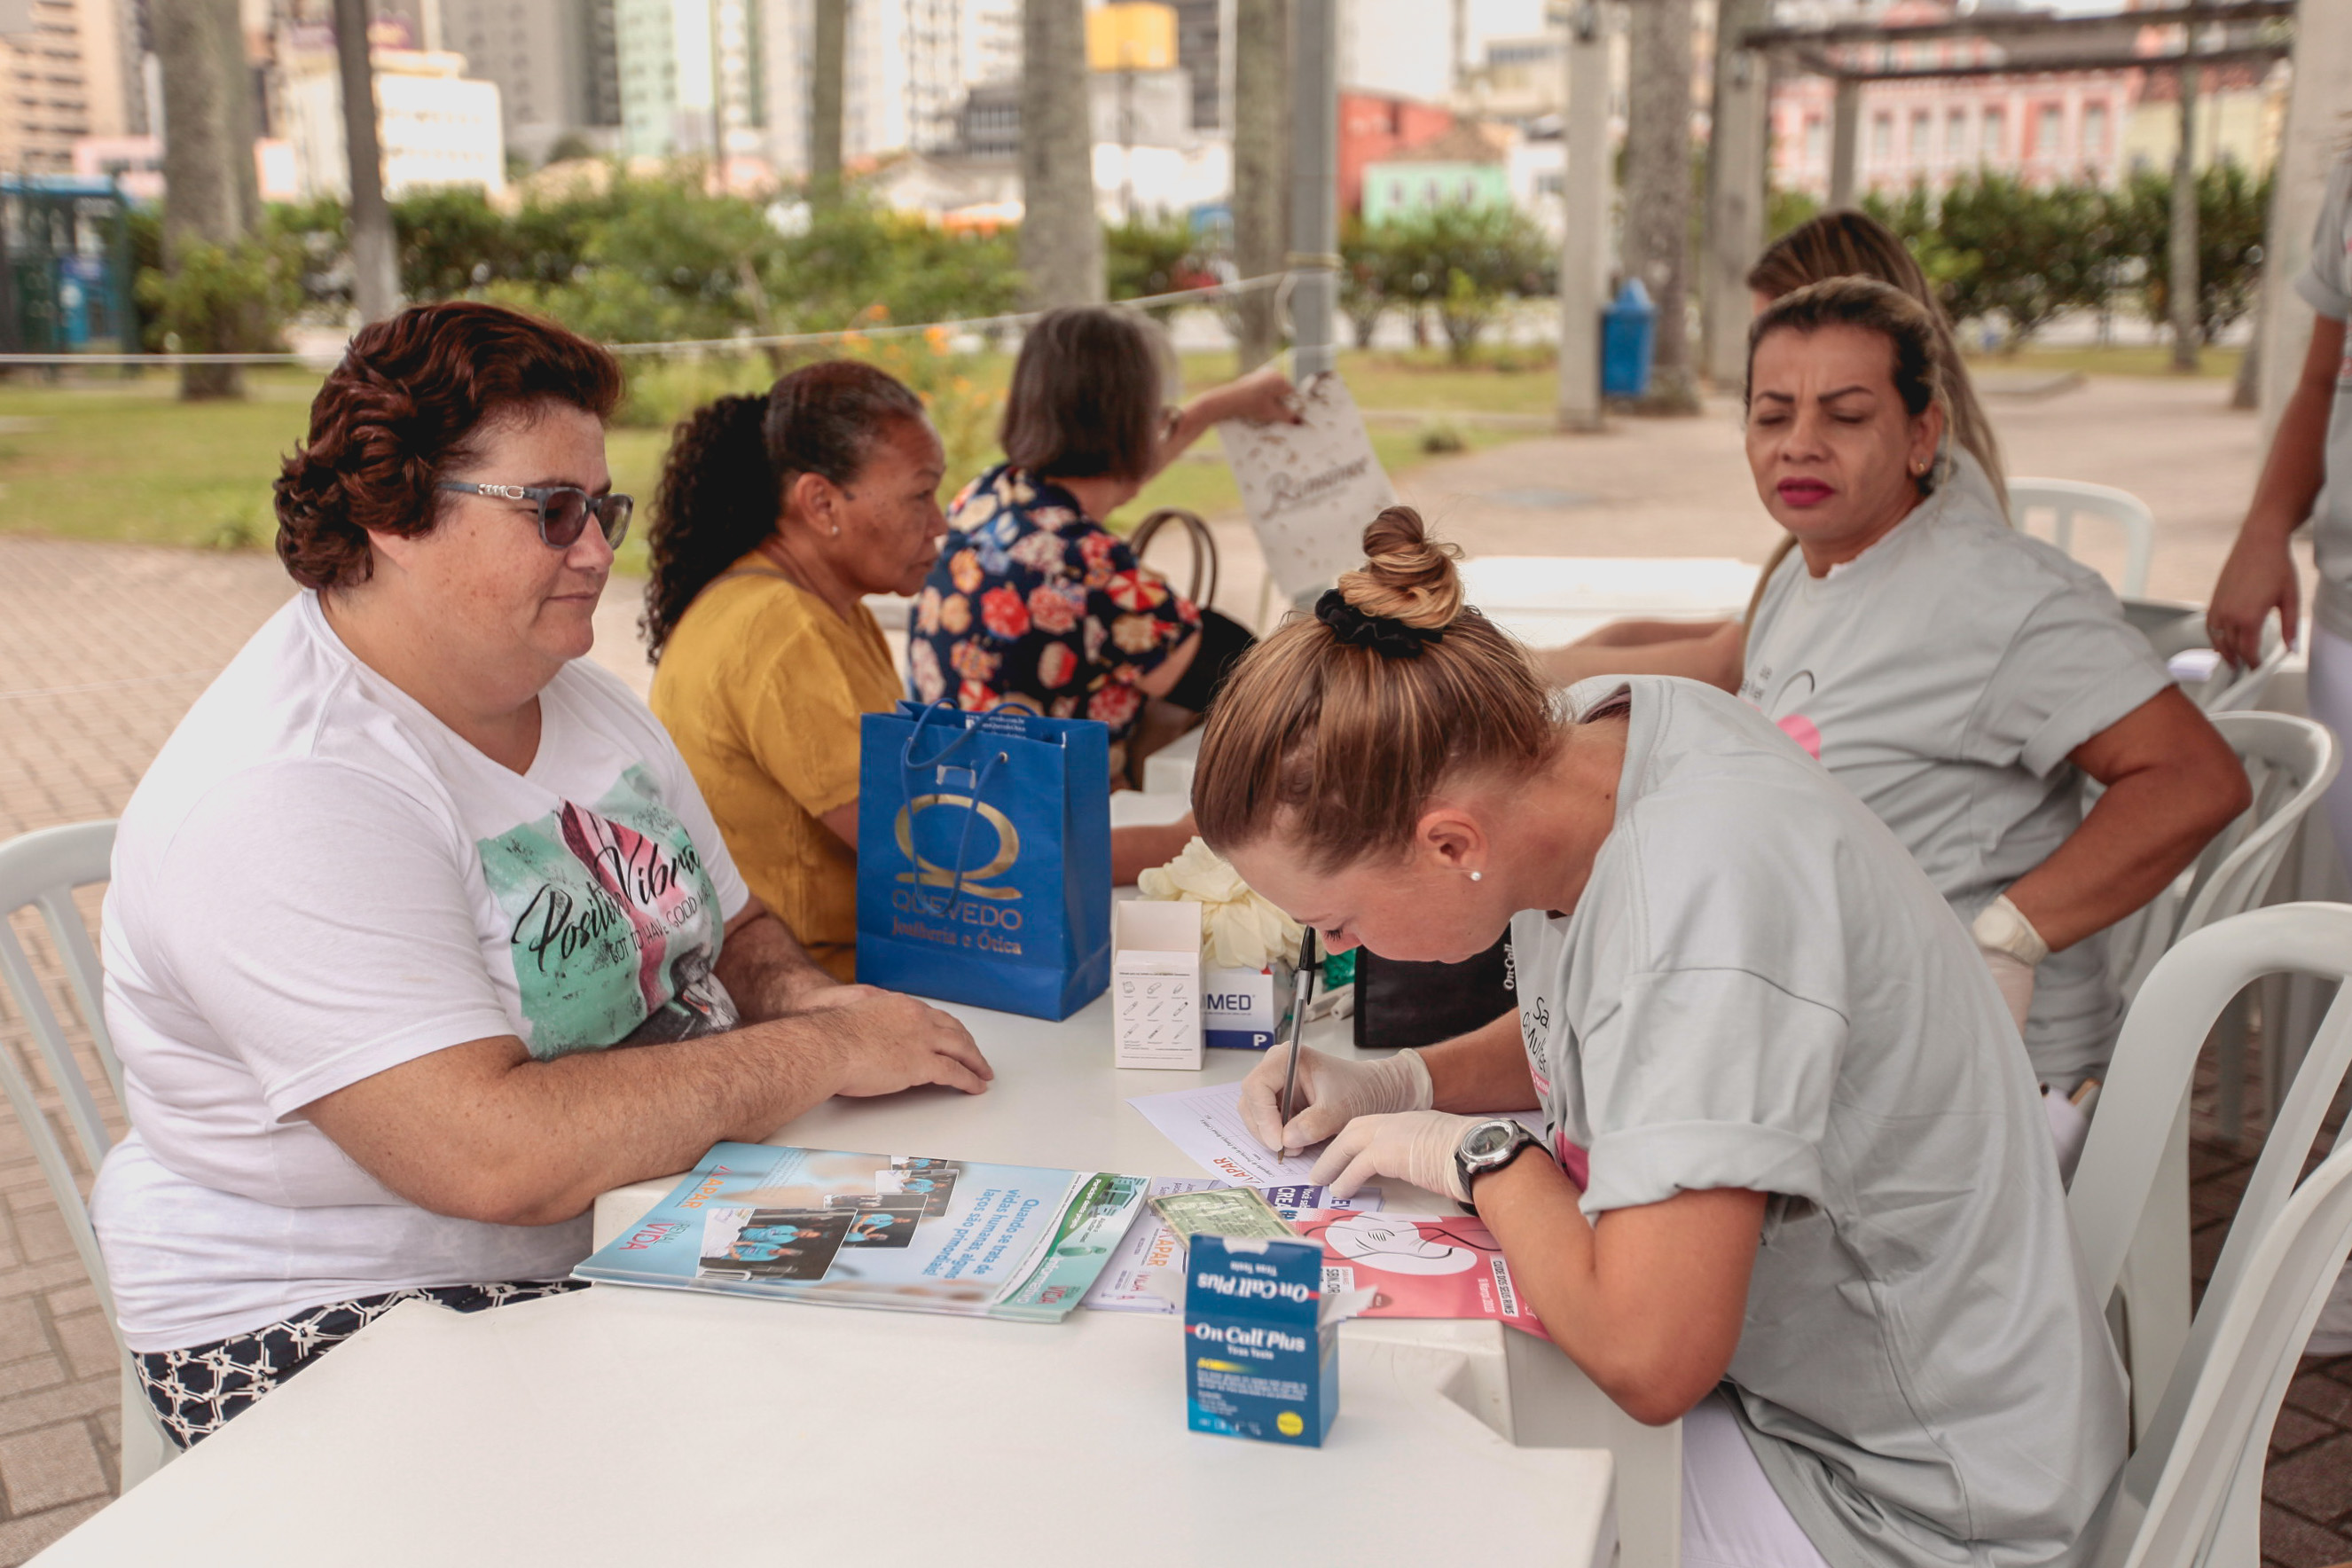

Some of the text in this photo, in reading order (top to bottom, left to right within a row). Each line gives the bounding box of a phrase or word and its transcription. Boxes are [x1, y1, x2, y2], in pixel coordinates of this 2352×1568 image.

[892, 890, 1023, 930] QUEVEDO
[609, 937, 630, 965] GOT
[631, 929, 644, 952] TO
[642, 919, 670, 945] HAVE
[666, 896, 697, 928] GOOD
[963, 935, 972, 947] e
[977, 928, 1023, 955] Ótica
[1201, 993, 1251, 1011] MED
[1533, 996, 1550, 1030] Sa
[1253, 1034, 1267, 1047] P
[1213, 1157, 1251, 1178] APAR
[680, 1178, 725, 1209] APAR
[974, 1188, 1002, 1211] laços
[1274, 1187, 1297, 1208] CREA
[1301, 1188, 1314, 1200] Você
[1330, 1196, 1352, 1211] EV
[962, 1212, 982, 1227] são
[618, 1223, 675, 1250] VIDA
[945, 1189, 1021, 1279] vidas humanas, alguns
[973, 1198, 1040, 1274] Quando se trata de
[1147, 1239, 1176, 1267] APAR
[1197, 1272, 1310, 1303] On Call Plus
[1327, 1268, 1340, 1293] SBN.OR
[1493, 1260, 1515, 1314] CUIDE DOS SEUS RINS
[1195, 1322, 1306, 1352] On Call Plus
